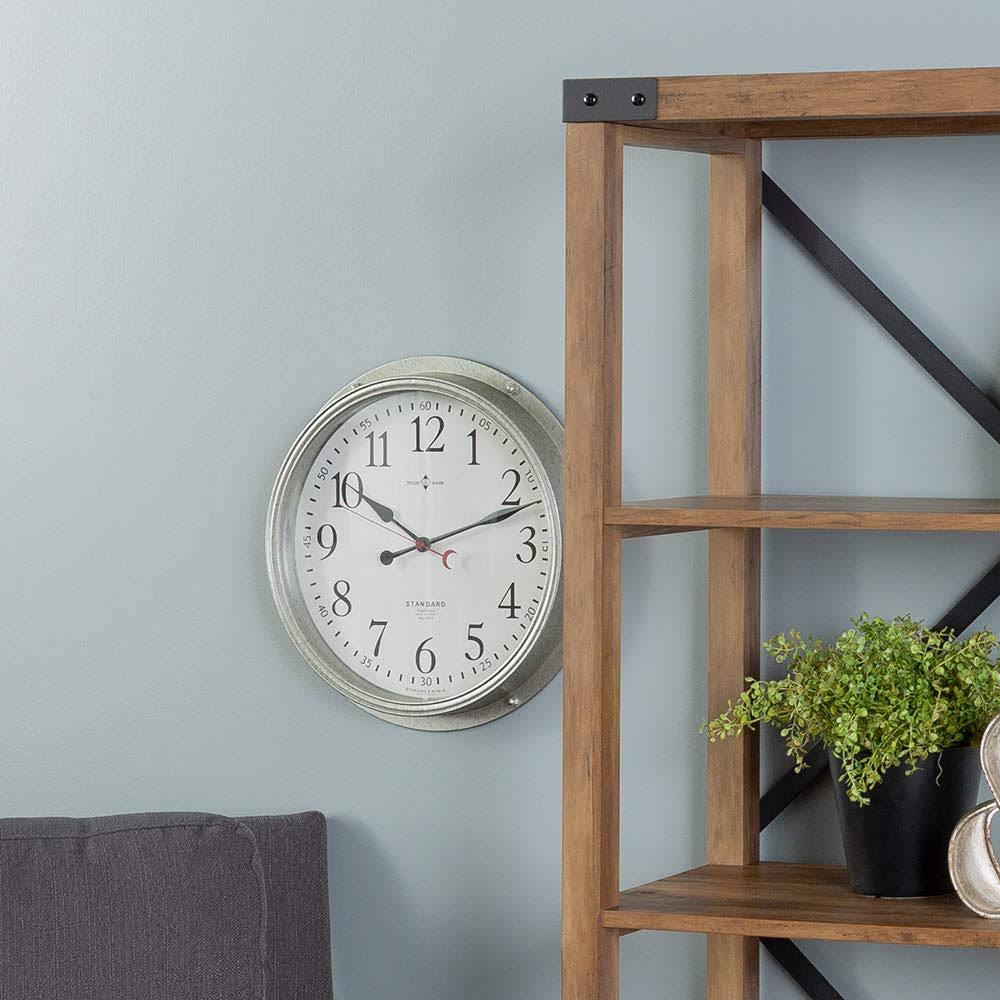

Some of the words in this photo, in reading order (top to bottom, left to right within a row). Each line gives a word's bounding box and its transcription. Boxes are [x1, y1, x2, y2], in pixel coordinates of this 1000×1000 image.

[359, 417, 372, 431] 55
[420, 402, 432, 411] 60
[479, 417, 493, 431] 05
[365, 430, 391, 467] 11
[411, 416, 445, 452] 12
[467, 429, 481, 465] 1
[318, 467, 329, 481] 50
[331, 471, 363, 508] 10
[501, 469, 521, 506] 2
[303, 535, 312, 549] 45
[317, 524, 337, 561] 9
[516, 526, 537, 564] 3
[318, 604, 329, 618] 40
[332, 580, 352, 617] 8
[498, 582, 522, 619] 4
[525, 607, 536, 621] 20
[369, 620, 388, 657] 7
[415, 637, 436, 674] 6
[465, 622, 484, 661] 5
[360, 656, 373, 668] 35
[480, 658, 493, 671] 25
[421, 676, 432, 686] 30
